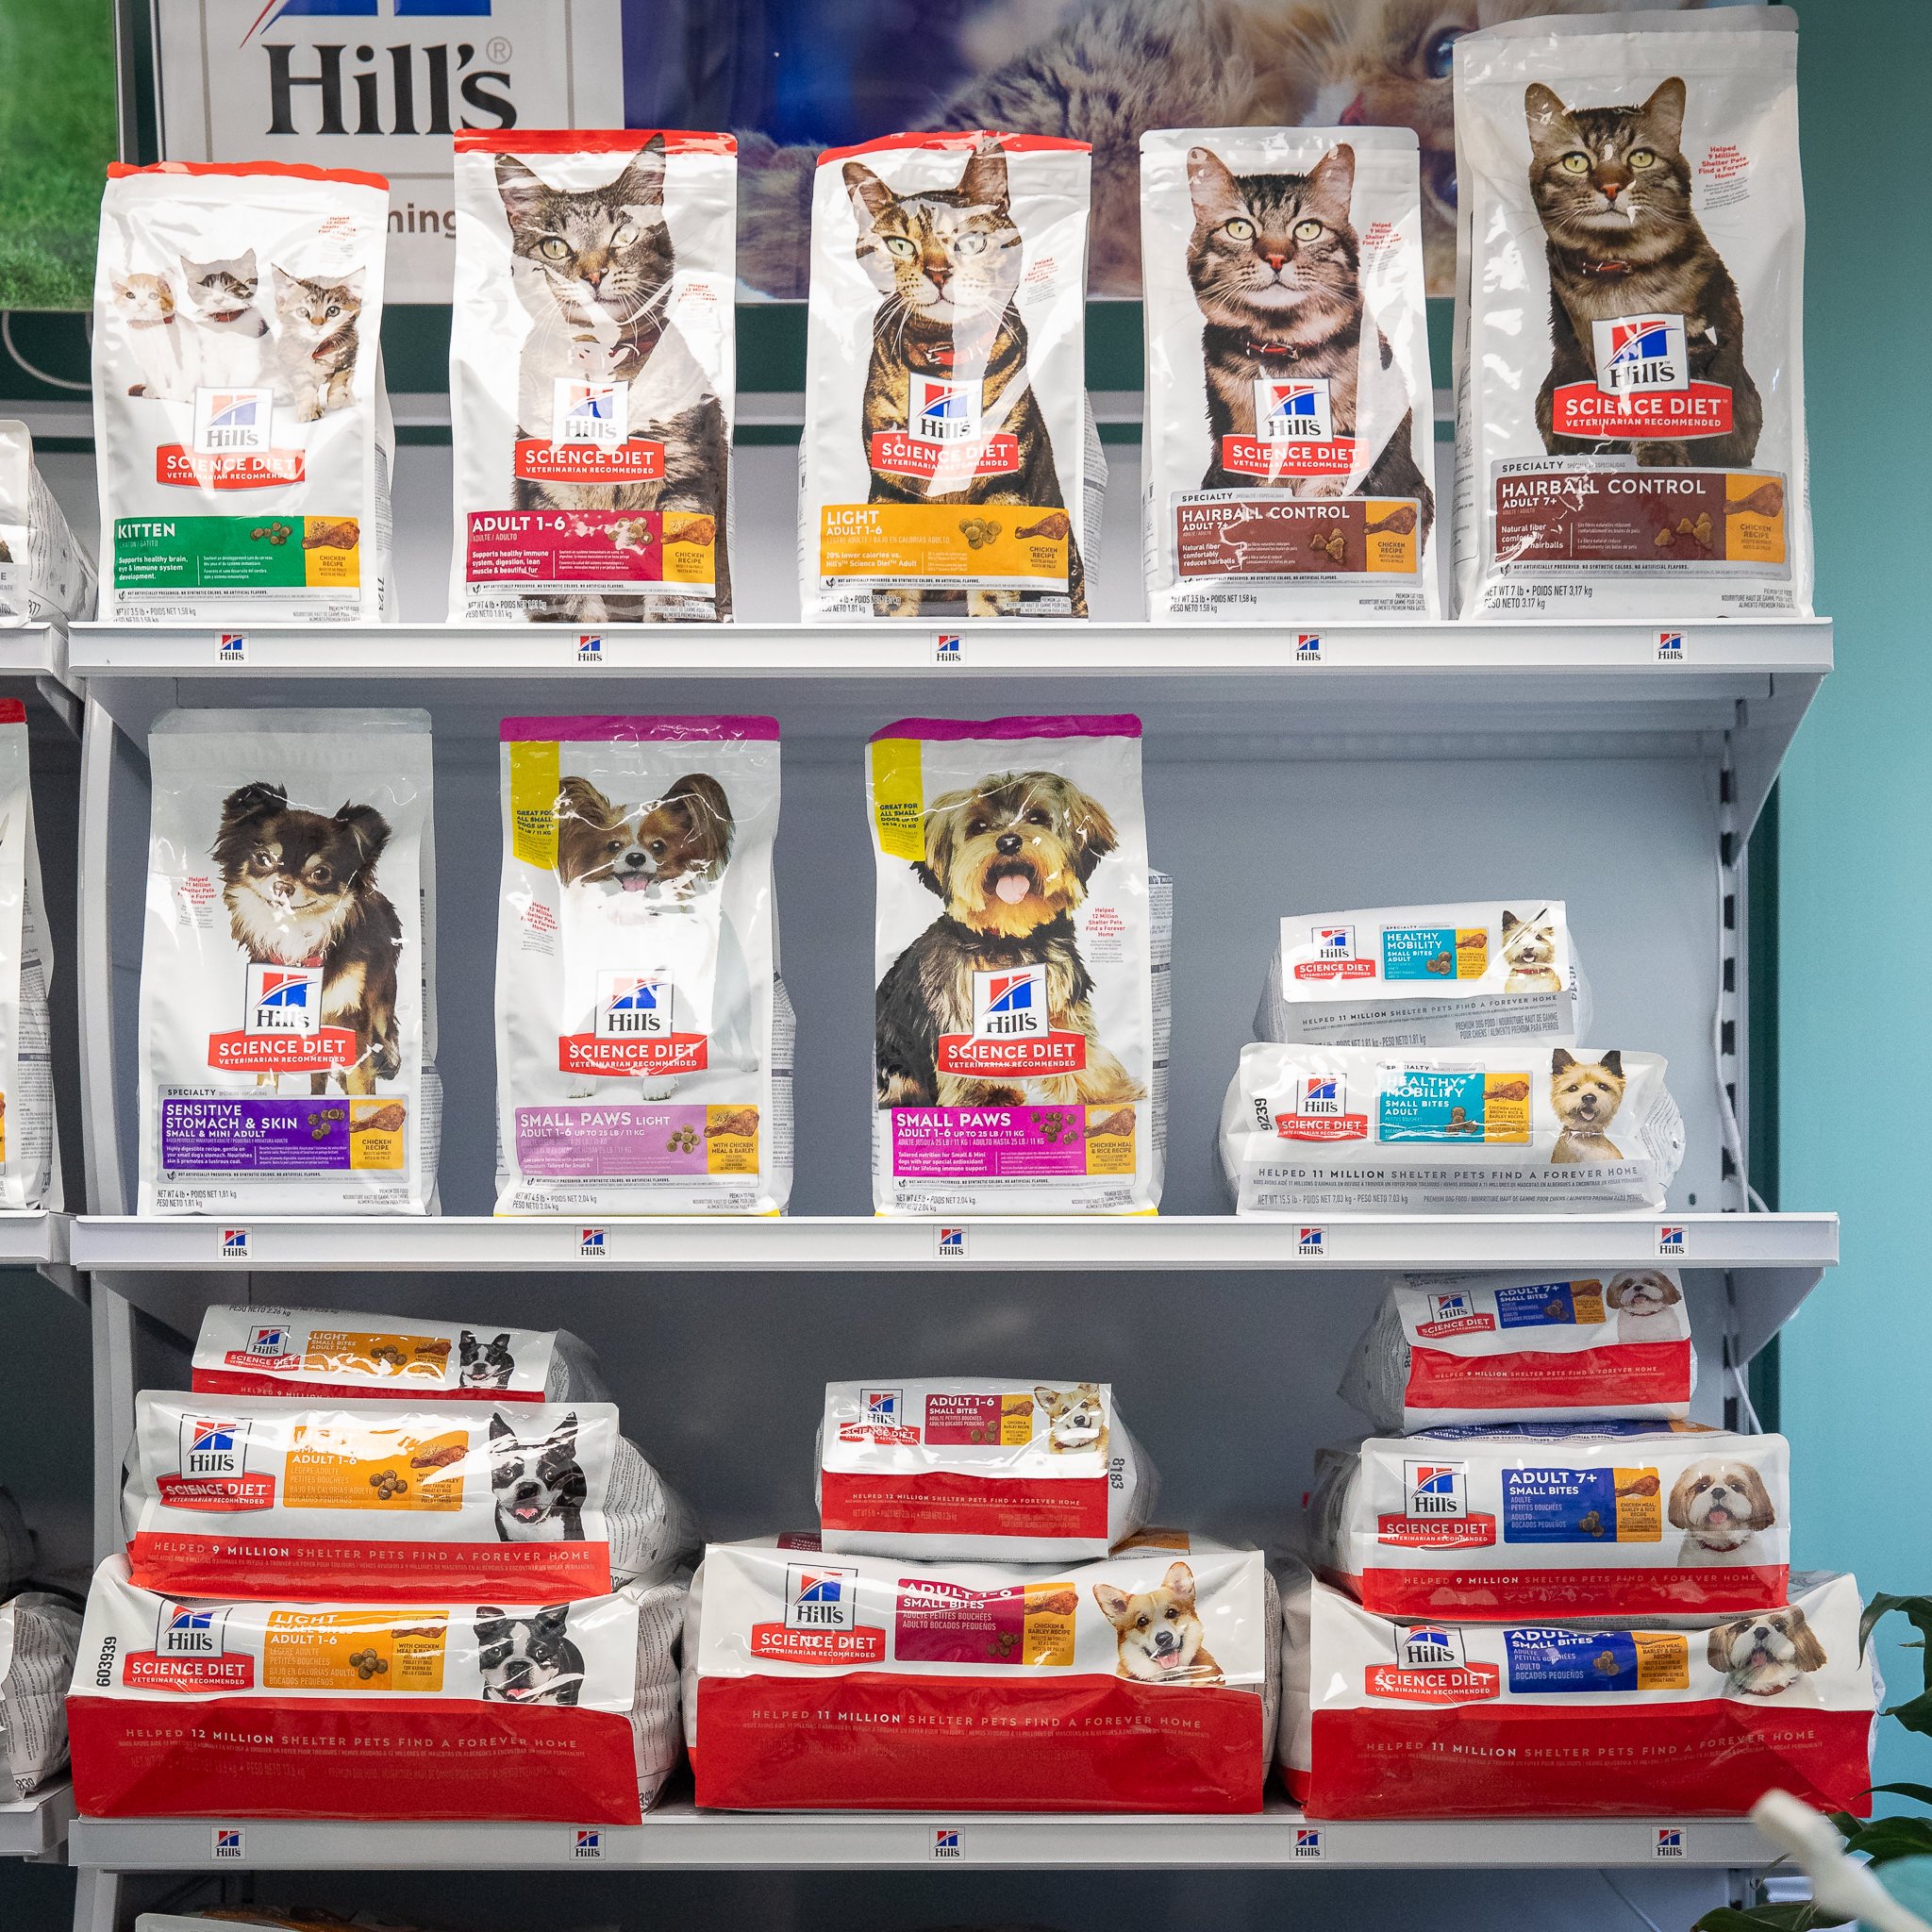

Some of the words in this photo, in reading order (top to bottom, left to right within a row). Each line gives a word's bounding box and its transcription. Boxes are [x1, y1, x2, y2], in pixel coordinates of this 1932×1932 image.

[262, 43, 518, 135] Hill's
[1610, 361, 1675, 388] Hill's
[1565, 398, 1663, 416] SCIENCE
[1670, 398, 1721, 415] DIET
[1269, 419, 1321, 437] Hill's
[167, 456, 246, 471] SCIENCE
[253, 458, 296, 471] DIET
[525, 450, 604, 464] SCIENCE
[611, 451, 655, 465] DIET
[1502, 478, 1599, 498] HAIRBALL
[1607, 479, 1707, 495] CONTROL
[1181, 492, 1233, 503] SPECIALTY
[1503, 497, 1539, 508] ADULT
[1542, 496, 1557, 507] 7+
[827, 510, 879, 525] LIGHT
[1182, 506, 1263, 524] HAIRBALL
[1270, 506, 1350, 519] CONTROL
[118, 523, 175, 538] KITTEN
[472, 517, 531, 532] ADULT
[537, 517, 566, 531] 1-6
[826, 526, 862, 536] ADULT
[865, 526, 882, 535] 1-6
[1182, 543, 1204, 552] Natural
[119, 556, 142, 564] Supports
[143, 556, 167, 564] healthy
[220, 652, 244, 661] Hill's
[577, 652, 603, 661] Hill's
[936, 652, 961, 661] Hill's
[1296, 652, 1321, 661] Hill's
[1657, 650, 1683, 660] Hill's
[1387, 932, 1439, 941] HEALTHY
[1387, 941, 1442, 950] MOBILITY
[1320, 947, 1349, 958] Hill's
[1299, 963, 1344, 973] SCIENCE
[1347, 964, 1371, 973] DIET
[608, 1013, 660, 1031] Hill's
[986, 1013, 1038, 1033] Hill's
[219, 1040, 297, 1056] SCIENCE
[303, 1040, 346, 1055] DIET
[569, 1044, 649, 1058] SCIENCE
[655, 1044, 696, 1058] DIET
[947, 1044, 1027, 1059] SCIENCE
[1033, 1043, 1075, 1058] DIET
[166, 1105, 242, 1116] SENSITIVE
[1305, 1099, 1338, 1113] Hill's
[521, 1112, 574, 1127] SMALL
[581, 1112, 632, 1126] PAWS
[636, 1116, 670, 1125] LIGHT
[896, 1112, 954, 1127] SMALL
[959, 1112, 1011, 1126] PAWS
[1255, 1098, 1273, 1130] 9239
[166, 1118, 242, 1129] STOMACH
[244, 1119, 256, 1129] &
[261, 1118, 297, 1128] SKIN
[1281, 1120, 1332, 1130] SCIENCE
[1335, 1121, 1362, 1129] DIET
[520, 1128, 553, 1138] ADULT
[555, 1127, 572, 1137] 1-6
[898, 1128, 932, 1138] ADULT
[934, 1128, 951, 1137] 1-6
[1258, 1169, 1307, 1178] HELPED
[1312, 1170, 1323, 1178] 11
[1330, 1170, 1385, 1179] MILLION
[1391, 1170, 1446, 1179] SHELTER
[1454, 1170, 1485, 1179] PETS
[1491, 1170, 1523, 1179] FIND
[1529, 1170, 1537, 1178] A
[1543, 1169, 1602, 1179] FOREVER
[1607, 1166, 1638, 1176] HOME
[223, 1247, 248, 1257] Hill's
[581, 1247, 606, 1257] Hill's
[939, 1246, 963, 1256] Hill's
[1298, 1245, 1324, 1256] Hill's
[1659, 1244, 1685, 1255] Hill's
[1499, 1287, 1539, 1297] ADULT
[1543, 1285, 1559, 1293] 7+
[1440, 1307, 1468, 1320] Hill's
[251, 1344, 279, 1355] Hill's
[929, 1397, 972, 1407] ADULT
[974, 1397, 994, 1407] 1-6
[190, 1455, 234, 1472] Hill's
[292, 1455, 334, 1464] ADULT
[338, 1456, 358, 1465] 1-6
[1110, 1457, 1125, 1490] 8183
[1509, 1473, 1569, 1484] ADULT
[1575, 1473, 1597, 1484] 7+
[1509, 1487, 1547, 1495] SMALL
[1549, 1486, 1578, 1494] BITES
[1415, 1498, 1457, 1512] Hill's
[1387, 1524, 1451, 1534] SCIENCE
[1454, 1524, 1488, 1534] DIET
[155, 1541, 205, 1553] HELPED
[212, 1545, 220, 1554] 9
[227, 1545, 290, 1557] MILLION
[297, 1548, 361, 1558] SHELTER
[369, 1550, 405, 1559] PETS
[796, 1605, 843, 1624] Hill's
[167, 1632, 213, 1651] Hill's
[271, 1635, 313, 1644] ADULT
[318, 1635, 338, 1644] 1-6
[760, 1633, 834, 1648] SCIENCE
[838, 1636, 876, 1649] DIET
[1512, 1641, 1554, 1649] SMALL
[1557, 1637, 1593, 1645] BITES
[1407, 1645, 1455, 1663] Hill's
[96, 1636, 117, 1687] 603939
[132, 1662, 203, 1675] SCIENCE
[208, 1663, 245, 1676] DIET
[1516, 1671, 1547, 1679] BOCADOS
[215, 1846, 242, 1857] Hill's
[575, 1846, 600, 1858] Hill's
[935, 1847, 960, 1858] Hill's
[1295, 1847, 1321, 1857] Hill's
[1657, 1847, 1683, 1857] Hill's
